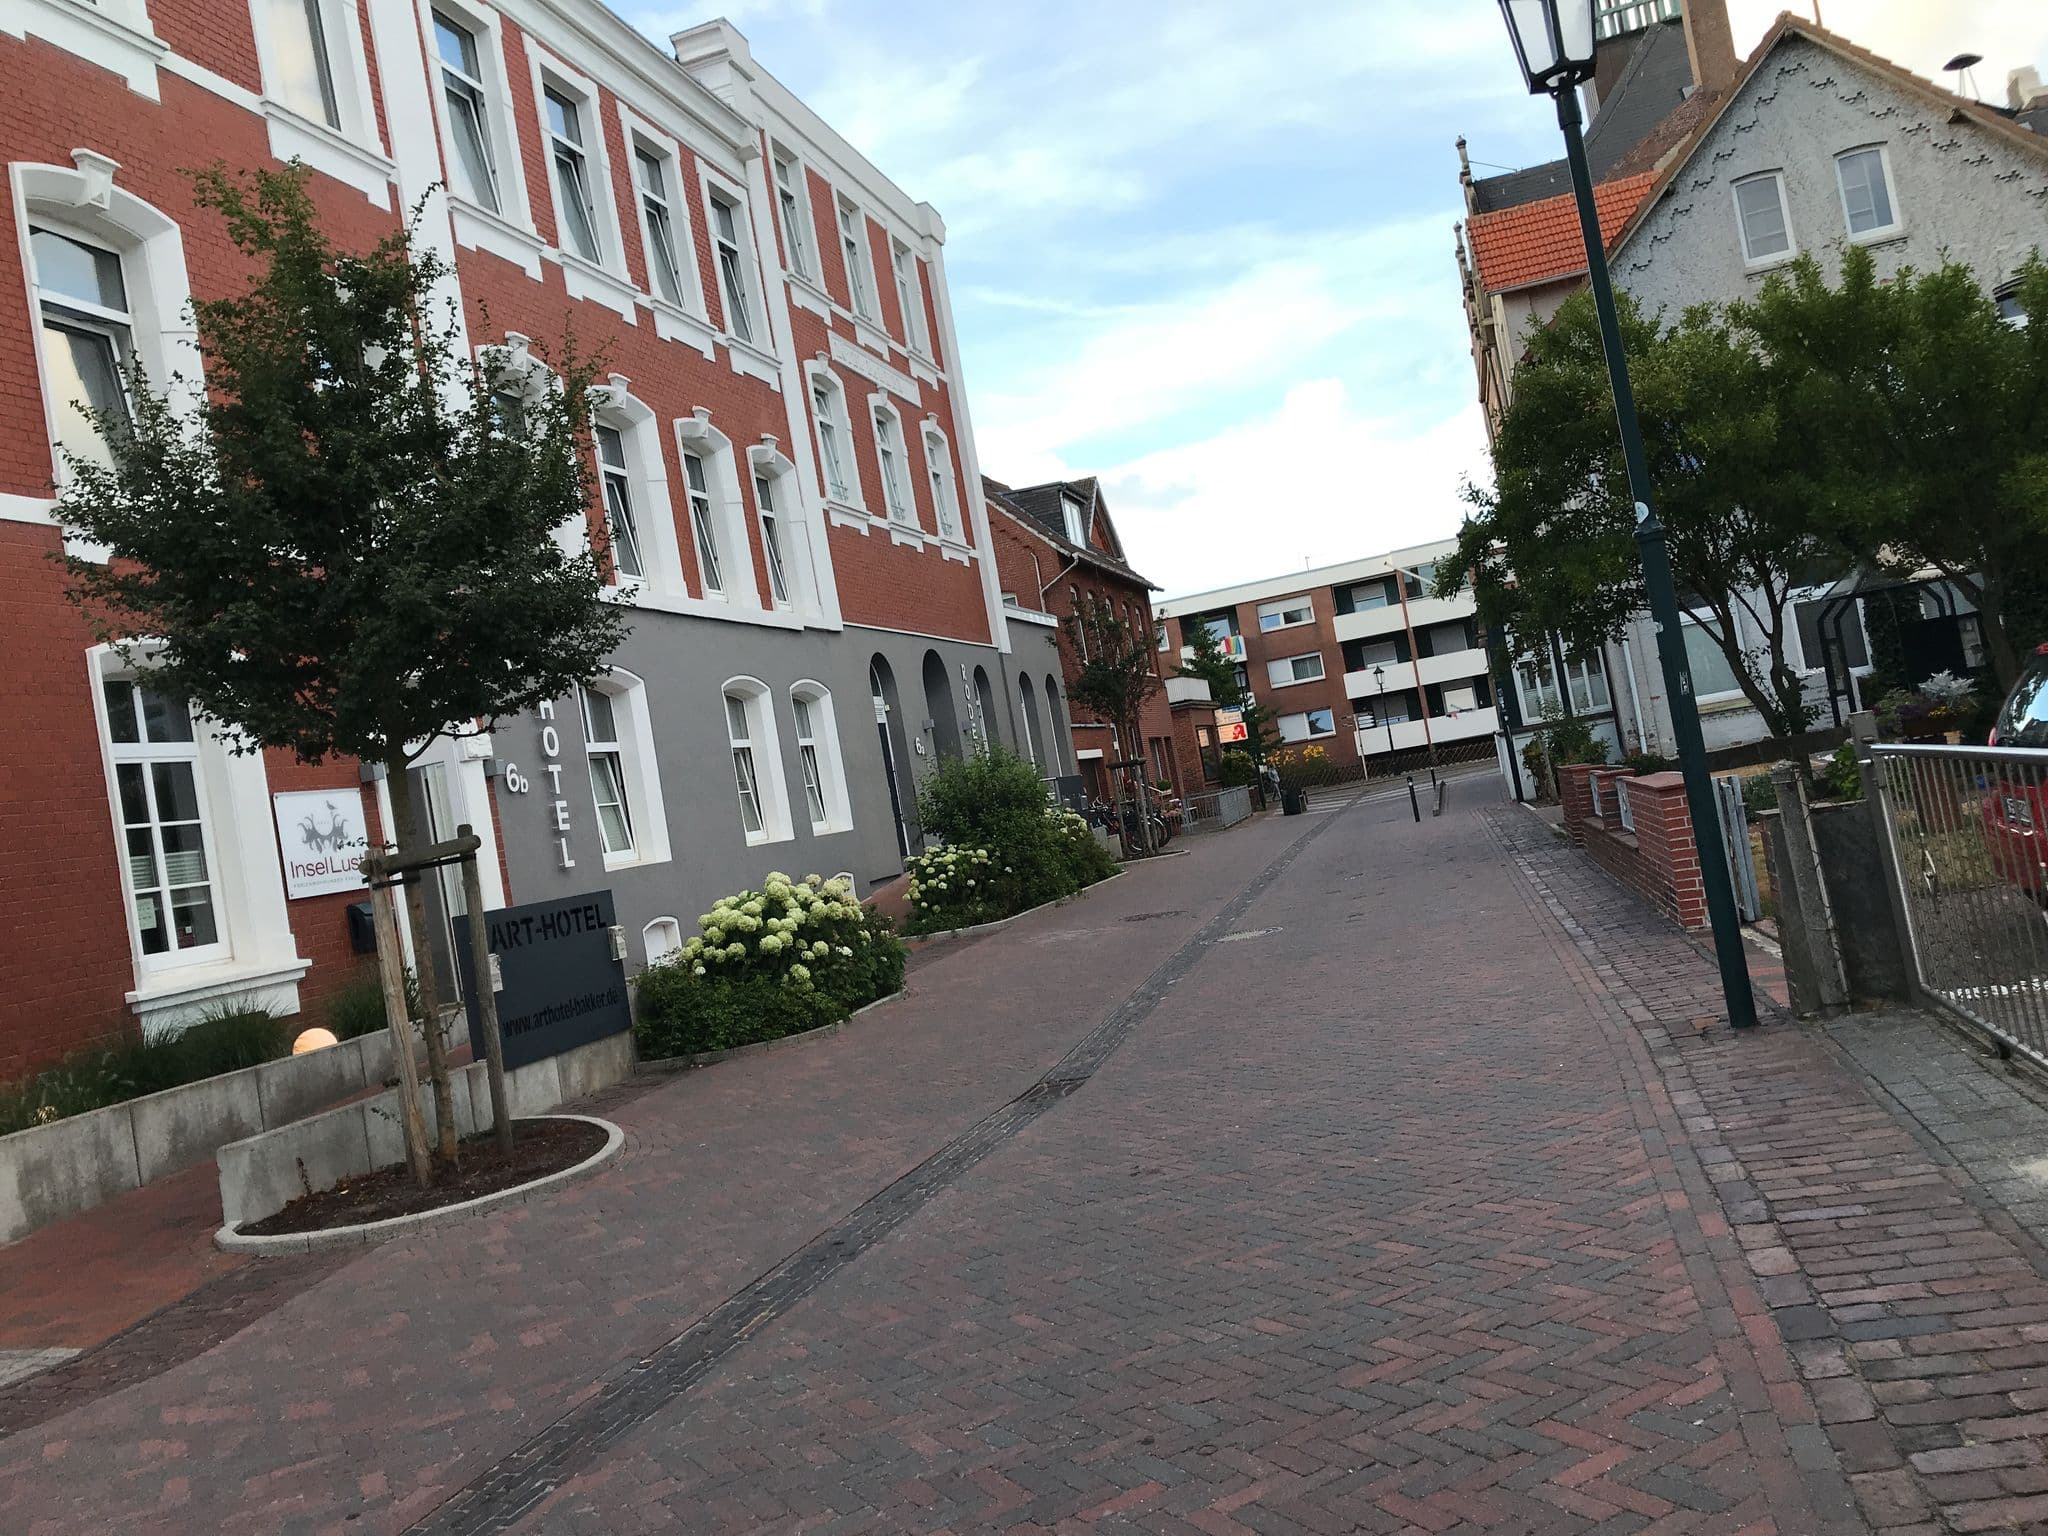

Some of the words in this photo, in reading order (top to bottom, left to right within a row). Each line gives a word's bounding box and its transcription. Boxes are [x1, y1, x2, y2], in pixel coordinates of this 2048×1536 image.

[506, 763, 529, 793] 6b
[539, 699, 576, 868] HOTEL
[490, 904, 607, 950] ART-HOTEL
